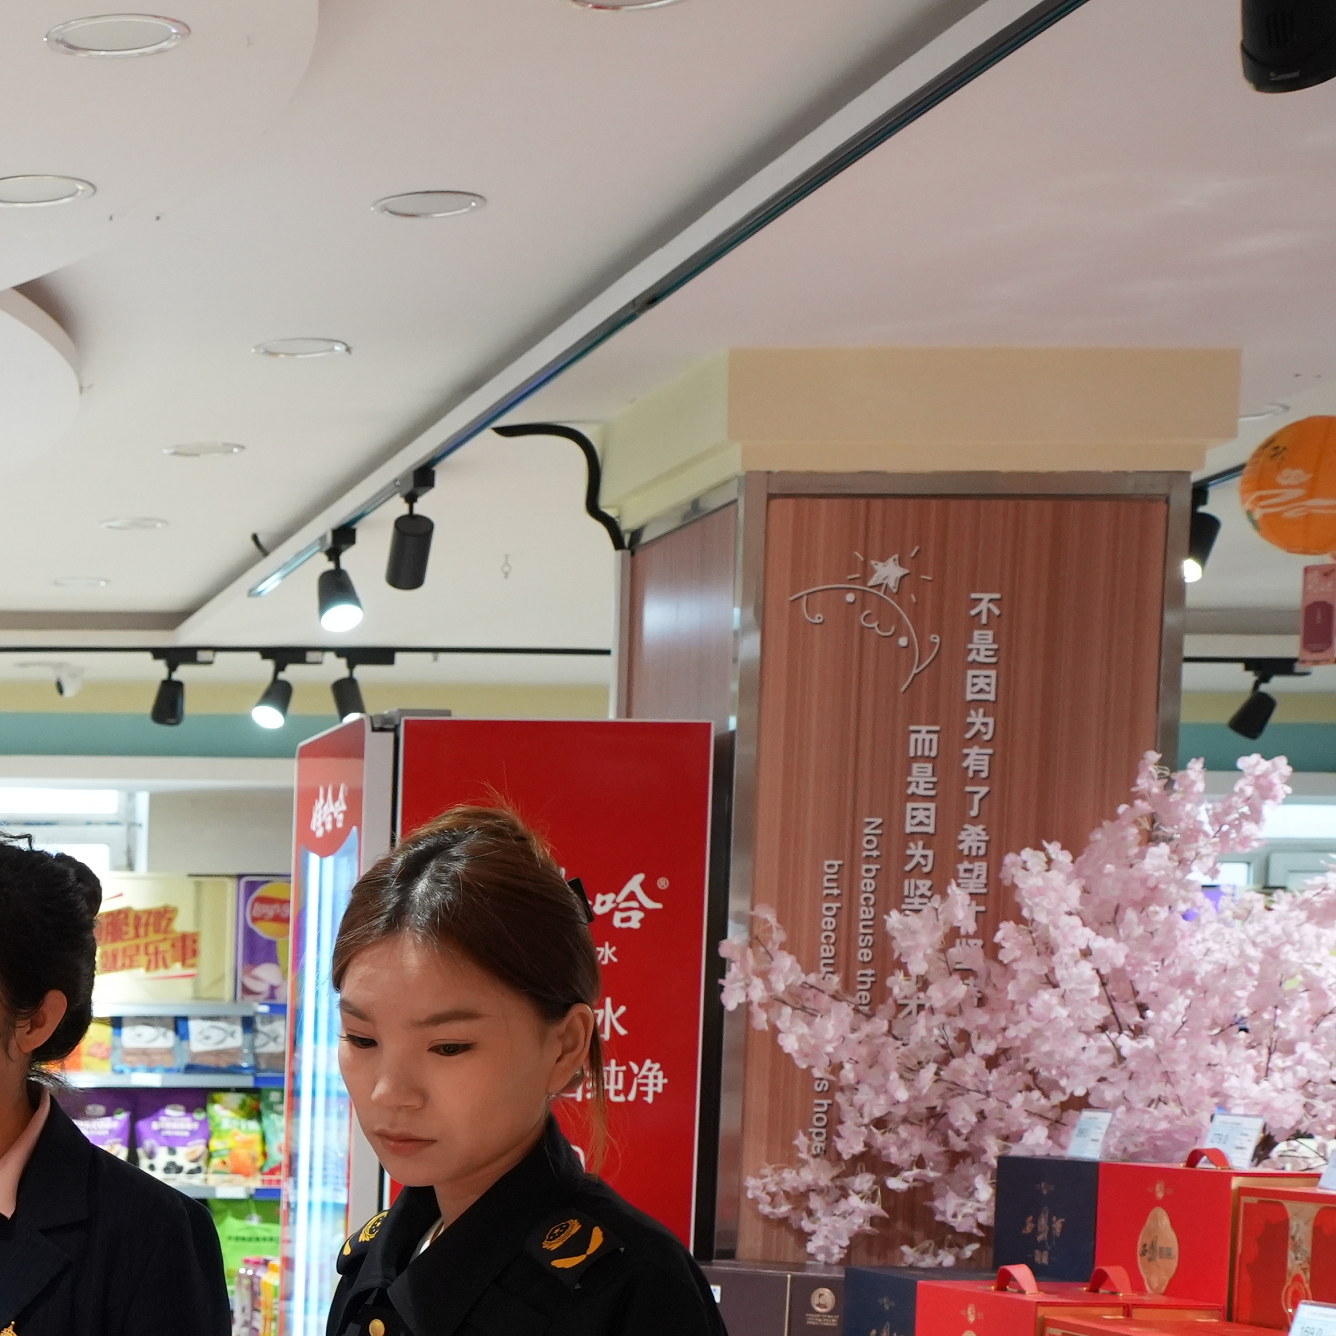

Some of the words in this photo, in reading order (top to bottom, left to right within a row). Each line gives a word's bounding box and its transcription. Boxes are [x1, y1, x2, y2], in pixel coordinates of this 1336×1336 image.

[862, 817, 883, 863] Not
[822, 860, 843, 889] but
[857, 866, 881, 964] because
